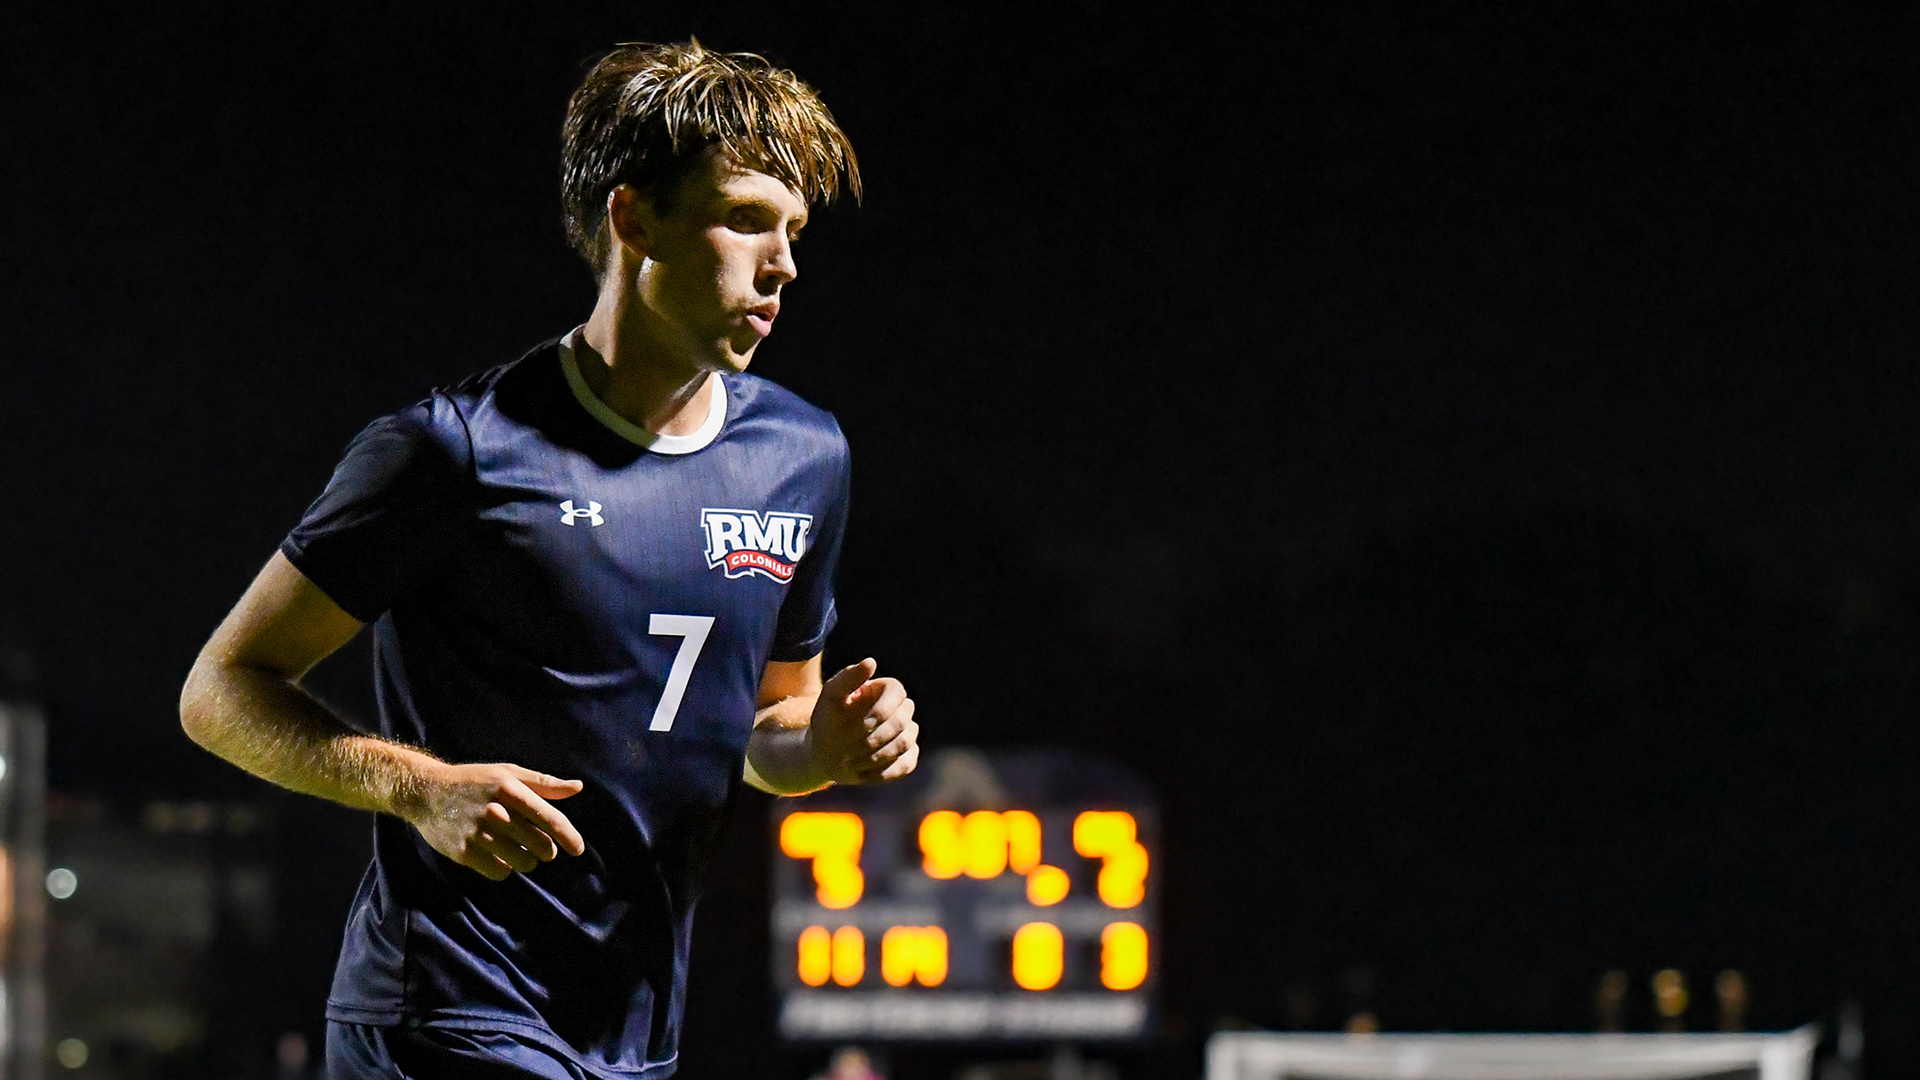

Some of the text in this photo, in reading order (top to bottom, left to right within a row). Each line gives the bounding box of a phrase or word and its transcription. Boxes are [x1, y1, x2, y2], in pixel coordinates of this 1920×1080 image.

[706, 513, 810, 562] RMU
[731, 553, 793, 577] COLONIALS
[648, 613, 716, 732] 7
